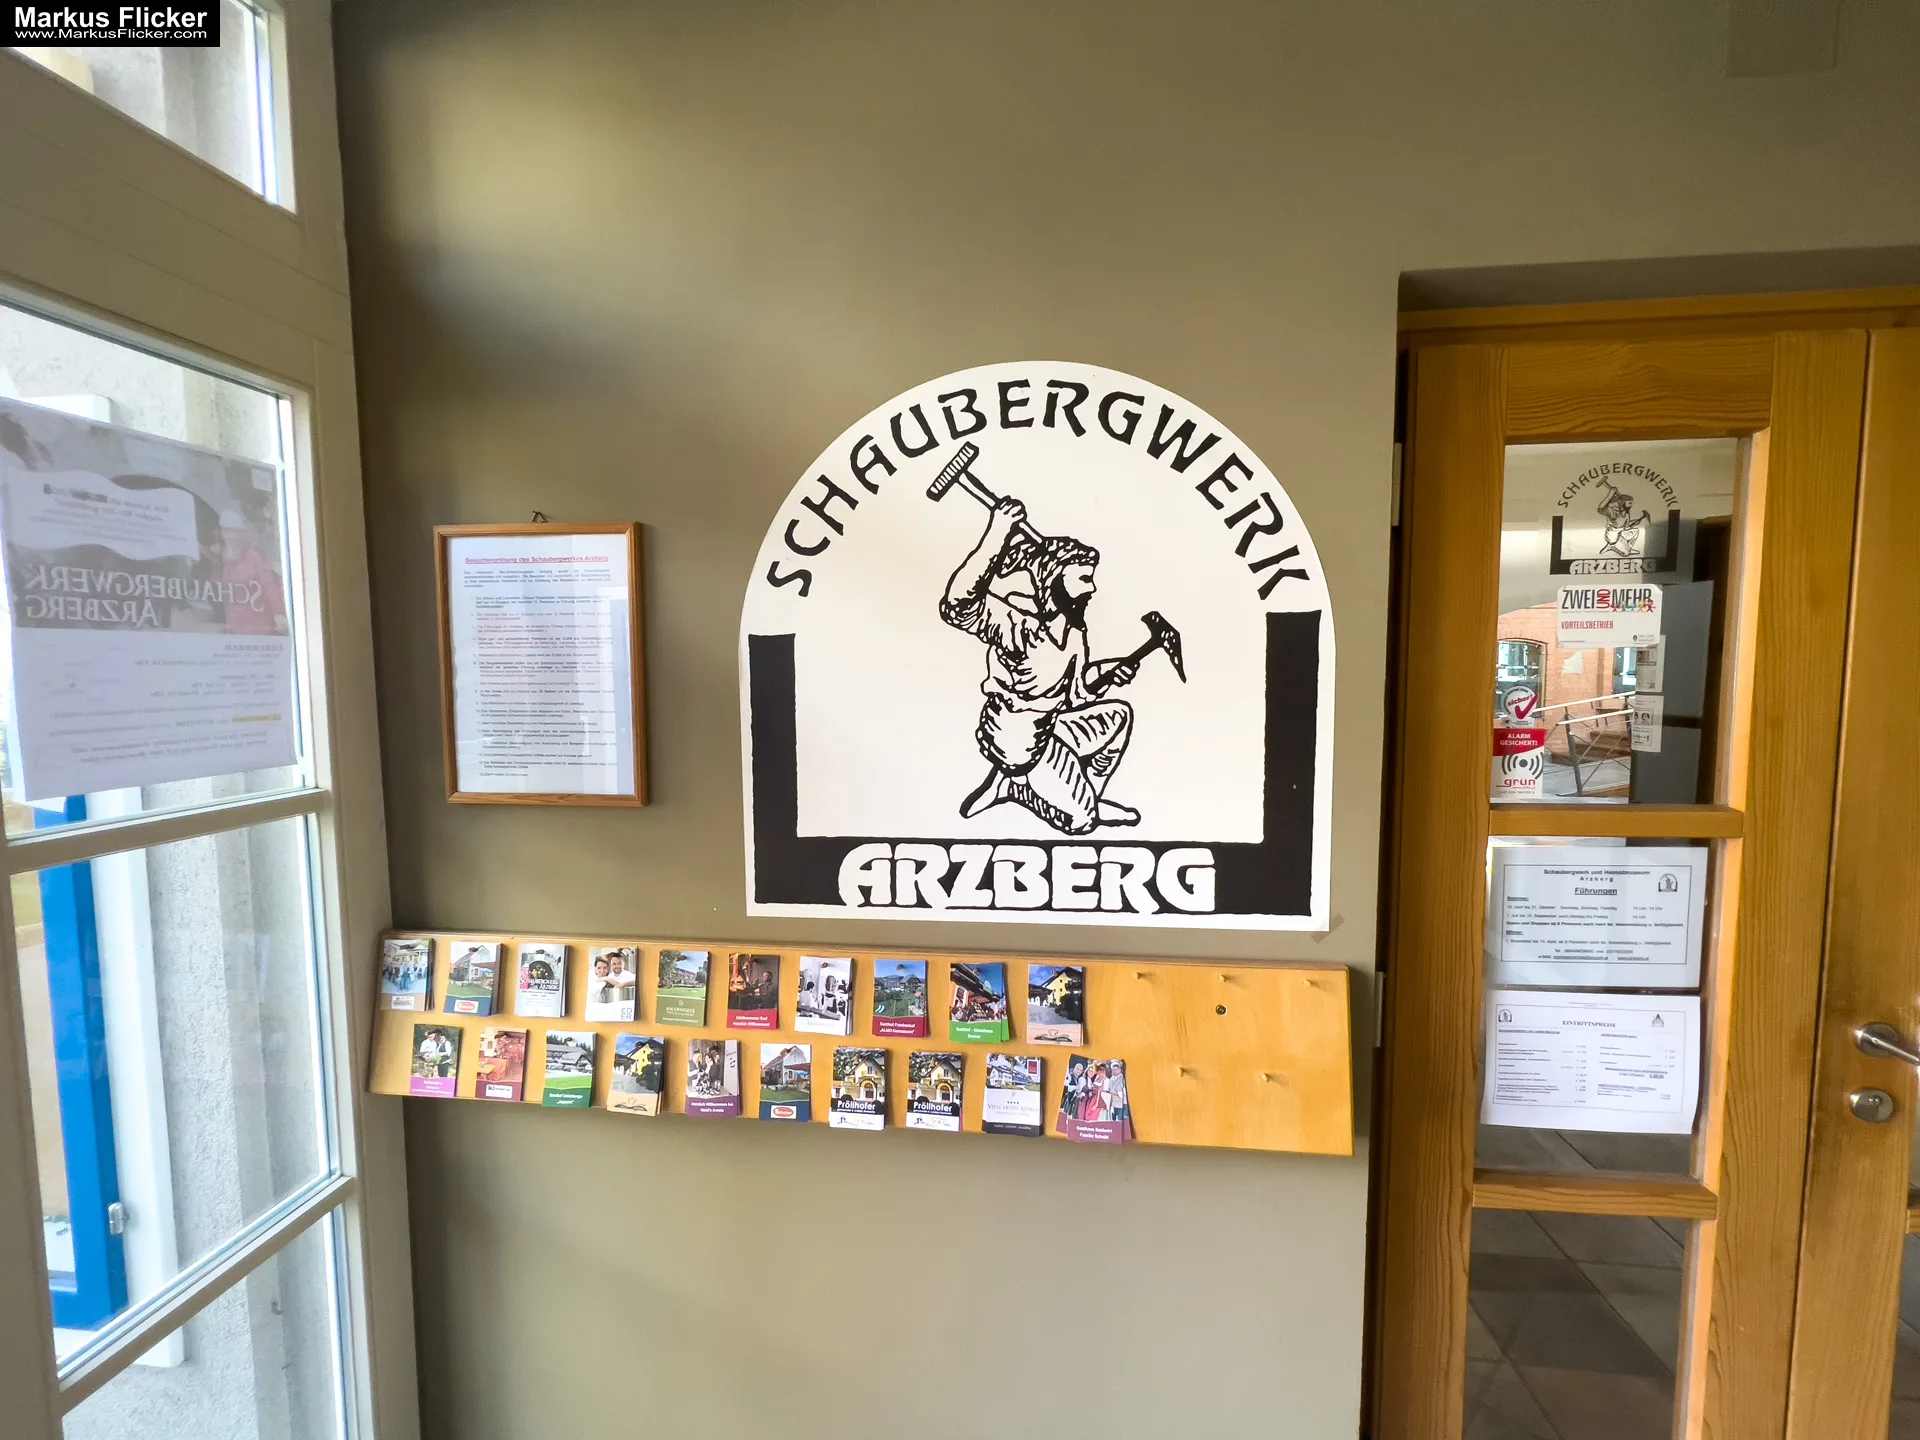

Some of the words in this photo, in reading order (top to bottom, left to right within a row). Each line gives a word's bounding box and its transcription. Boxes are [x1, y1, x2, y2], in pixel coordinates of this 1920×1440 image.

[766, 379, 1310, 600] SCHAUBERGWERK
[1557, 462, 1681, 509] SCHAUBERGWERK
[1569, 558, 1656, 575] ARZBERG
[1561, 588, 1595, 609] ZWEI
[1560, 620, 1614, 630] VORTEILSBETRIEB
[1499, 739, 1538, 747] GESICHERT!
[837, 841, 1217, 915] ARZBERG
[1574, 886, 1618, 895] Führungen
[837, 1099, 876, 1111] Pröllhofer
[913, 1101, 952, 1113] Pröllhofer
